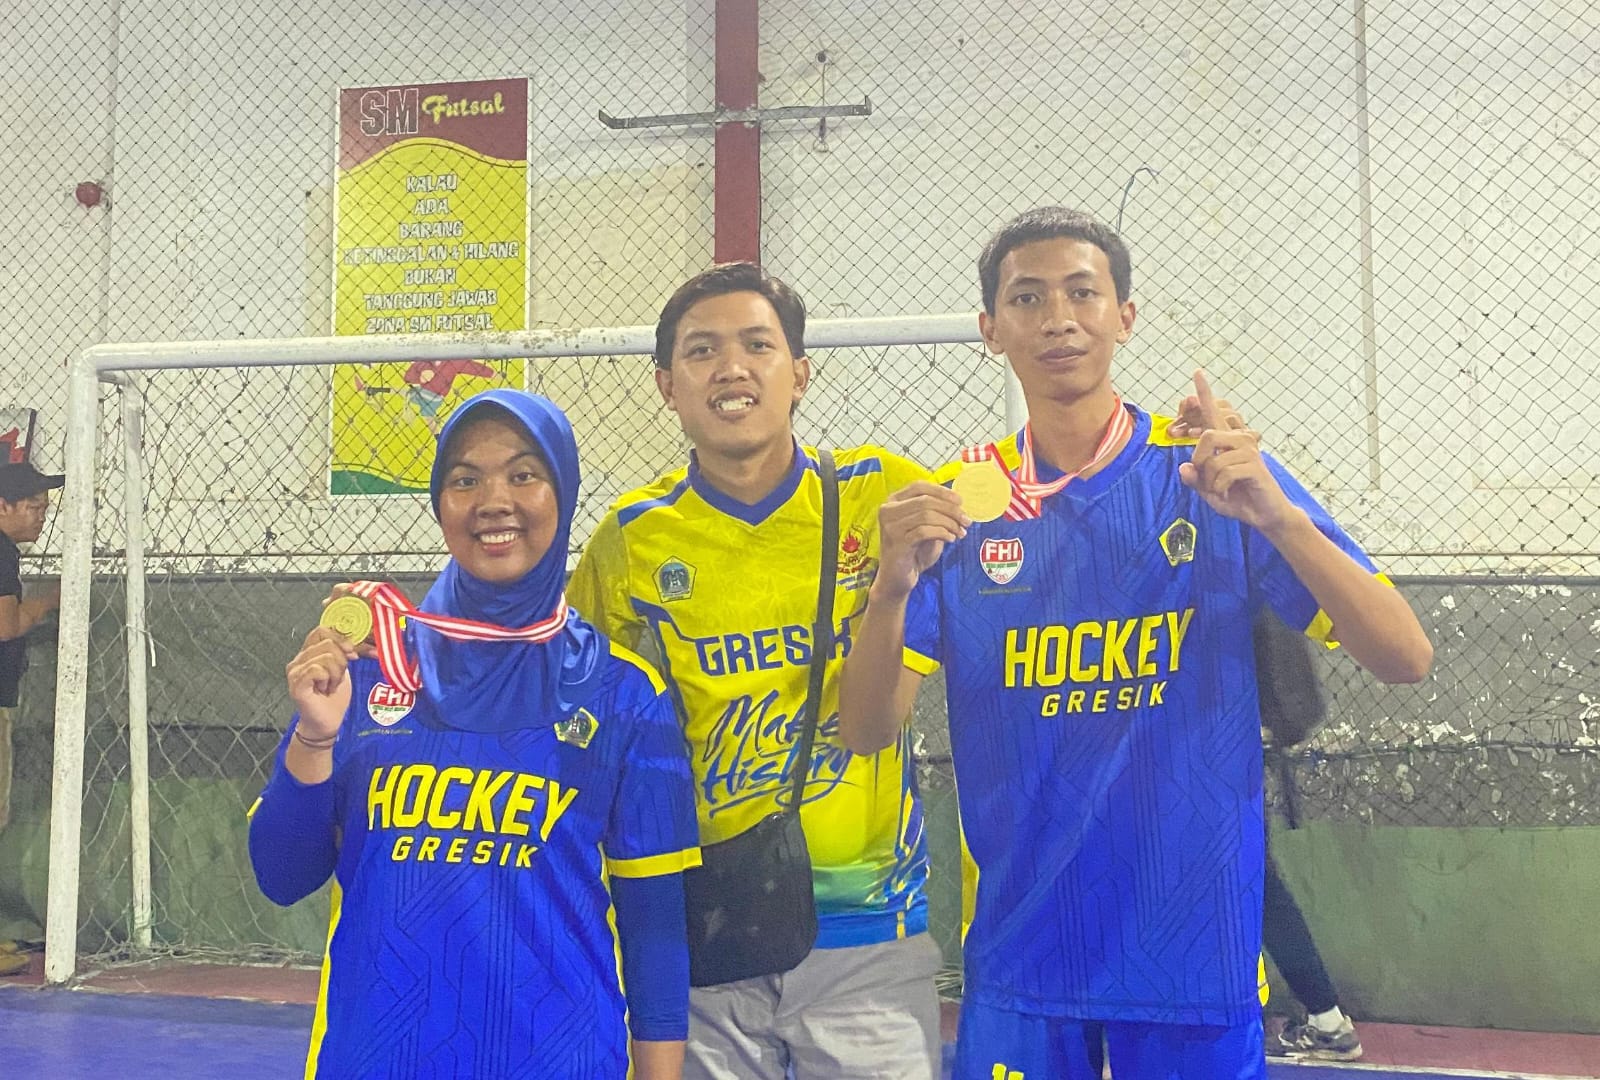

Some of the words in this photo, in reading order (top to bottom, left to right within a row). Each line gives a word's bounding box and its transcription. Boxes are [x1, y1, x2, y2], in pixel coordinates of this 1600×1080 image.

[360, 88, 418, 136] SM
[422, 92, 504, 124] Futsal
[406, 174, 458, 192] KALAU
[413, 198, 449, 215] ADA
[399, 221, 463, 238] BARANG
[464, 241, 519, 259] HILANG
[404, 268, 456, 285] BUKAN
[363, 292, 444, 310] TANGGUNG
[447, 289, 497, 307] JAWAB
[366, 316, 406, 334] ZONA
[409, 315, 432, 333] SM
[435, 313, 494, 331] FUTSAL
[985, 542, 1019, 561] FHI
[695, 617, 853, 676] GRESK
[1005, 608, 1195, 688] HOCKEY
[374, 686, 410, 705] FHI
[1041, 681, 1167, 717] GRESIK
[368, 764, 579, 842] HOCKEY
[391, 836, 538, 867] GRESIK
